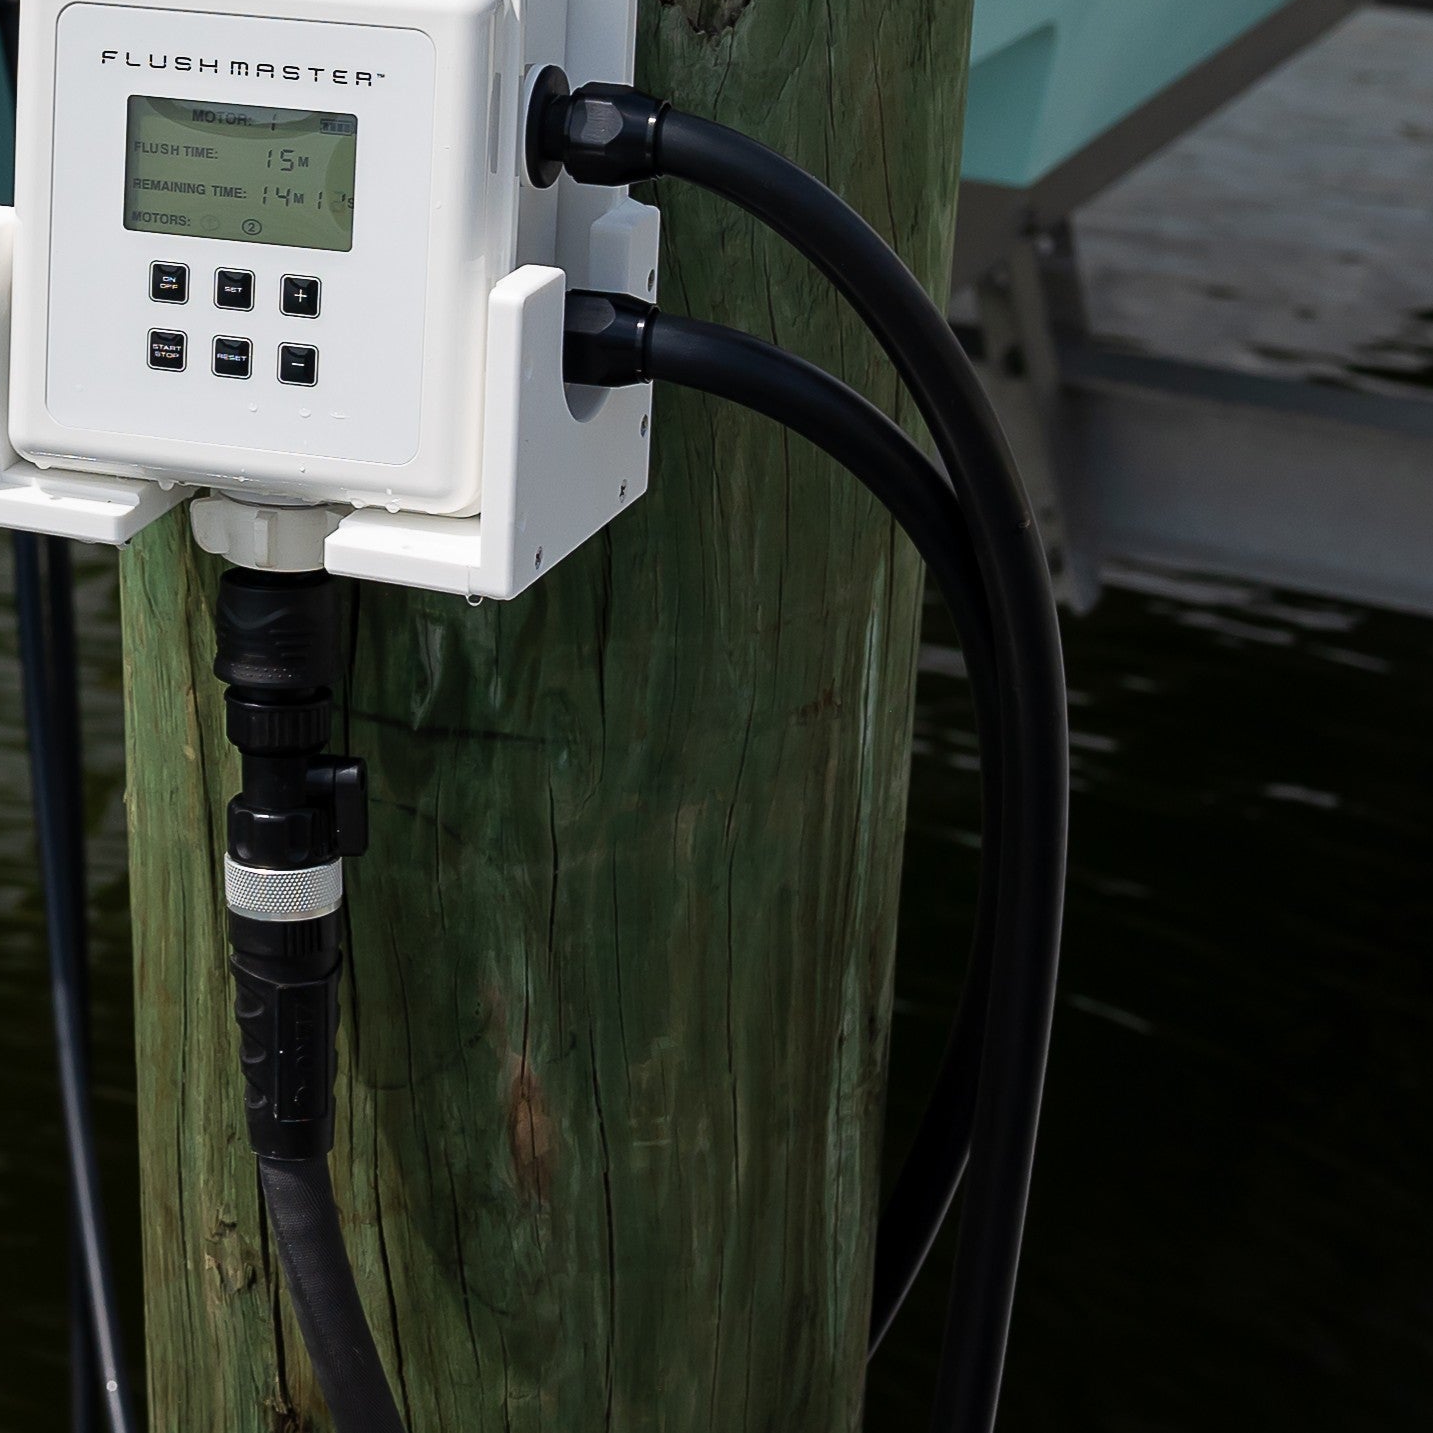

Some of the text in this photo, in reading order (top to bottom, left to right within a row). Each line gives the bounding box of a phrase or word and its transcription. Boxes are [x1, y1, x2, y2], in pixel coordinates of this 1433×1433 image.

[192, 109, 252, 126] MOTOR:
[134, 141, 180, 156] FLUSH
[183, 146, 218, 159] TIME:
[133, 178, 206, 195] REMAINING
[211, 185, 247, 199] TIME:
[132, 211, 191, 227] MOTORS:
[152, 343, 182, 352] START
[154, 351, 180, 359] STOP
[216, 353, 247, 362] RESET
